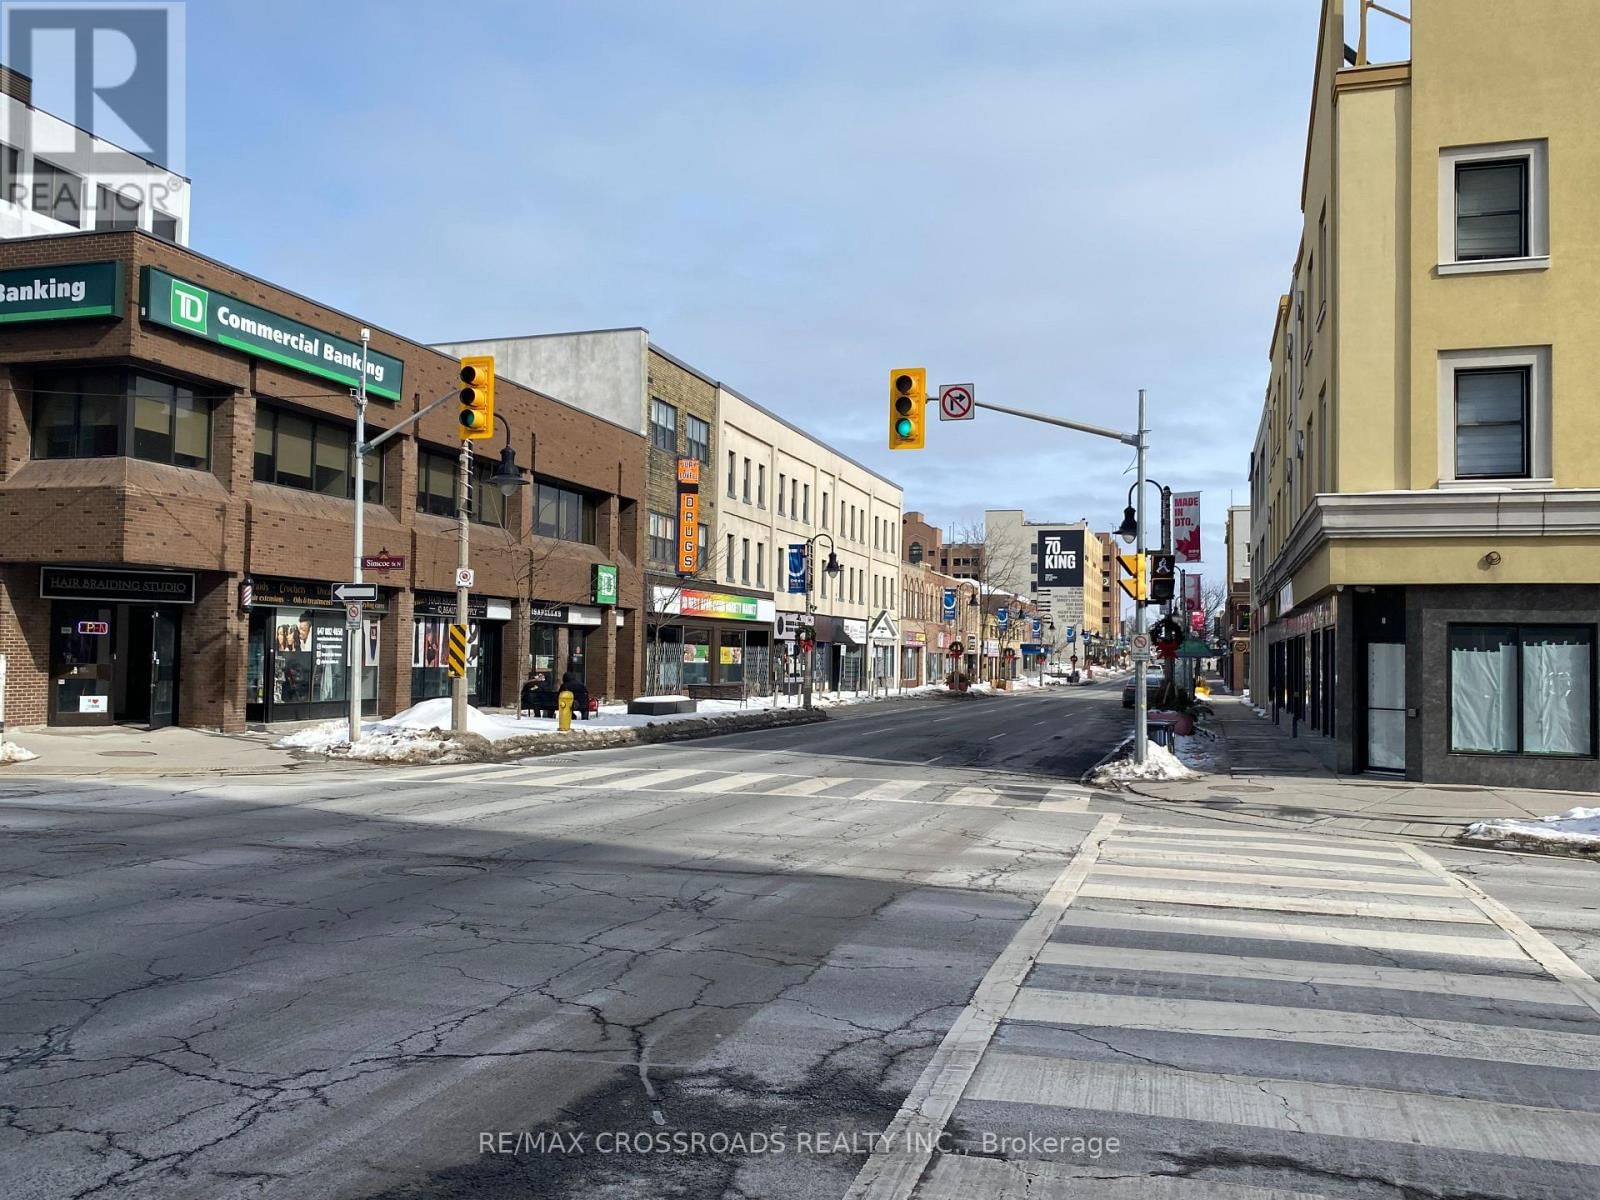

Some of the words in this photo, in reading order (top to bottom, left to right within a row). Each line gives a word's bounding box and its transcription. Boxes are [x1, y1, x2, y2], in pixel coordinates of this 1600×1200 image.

[175, 289, 203, 322] TD
[217, 306, 319, 357] Commercial
[1174, 497, 1198, 507] MADE
[1174, 508, 1183, 516] IN
[684, 497, 694, 567] DRUGS
[1045, 541, 1060, 554] 70
[1045, 555, 1076, 569] KING
[50, 577, 81, 588] HAIR
[83, 578, 142, 592] BRAIDING
[143, 581, 187, 593] STUDIO
